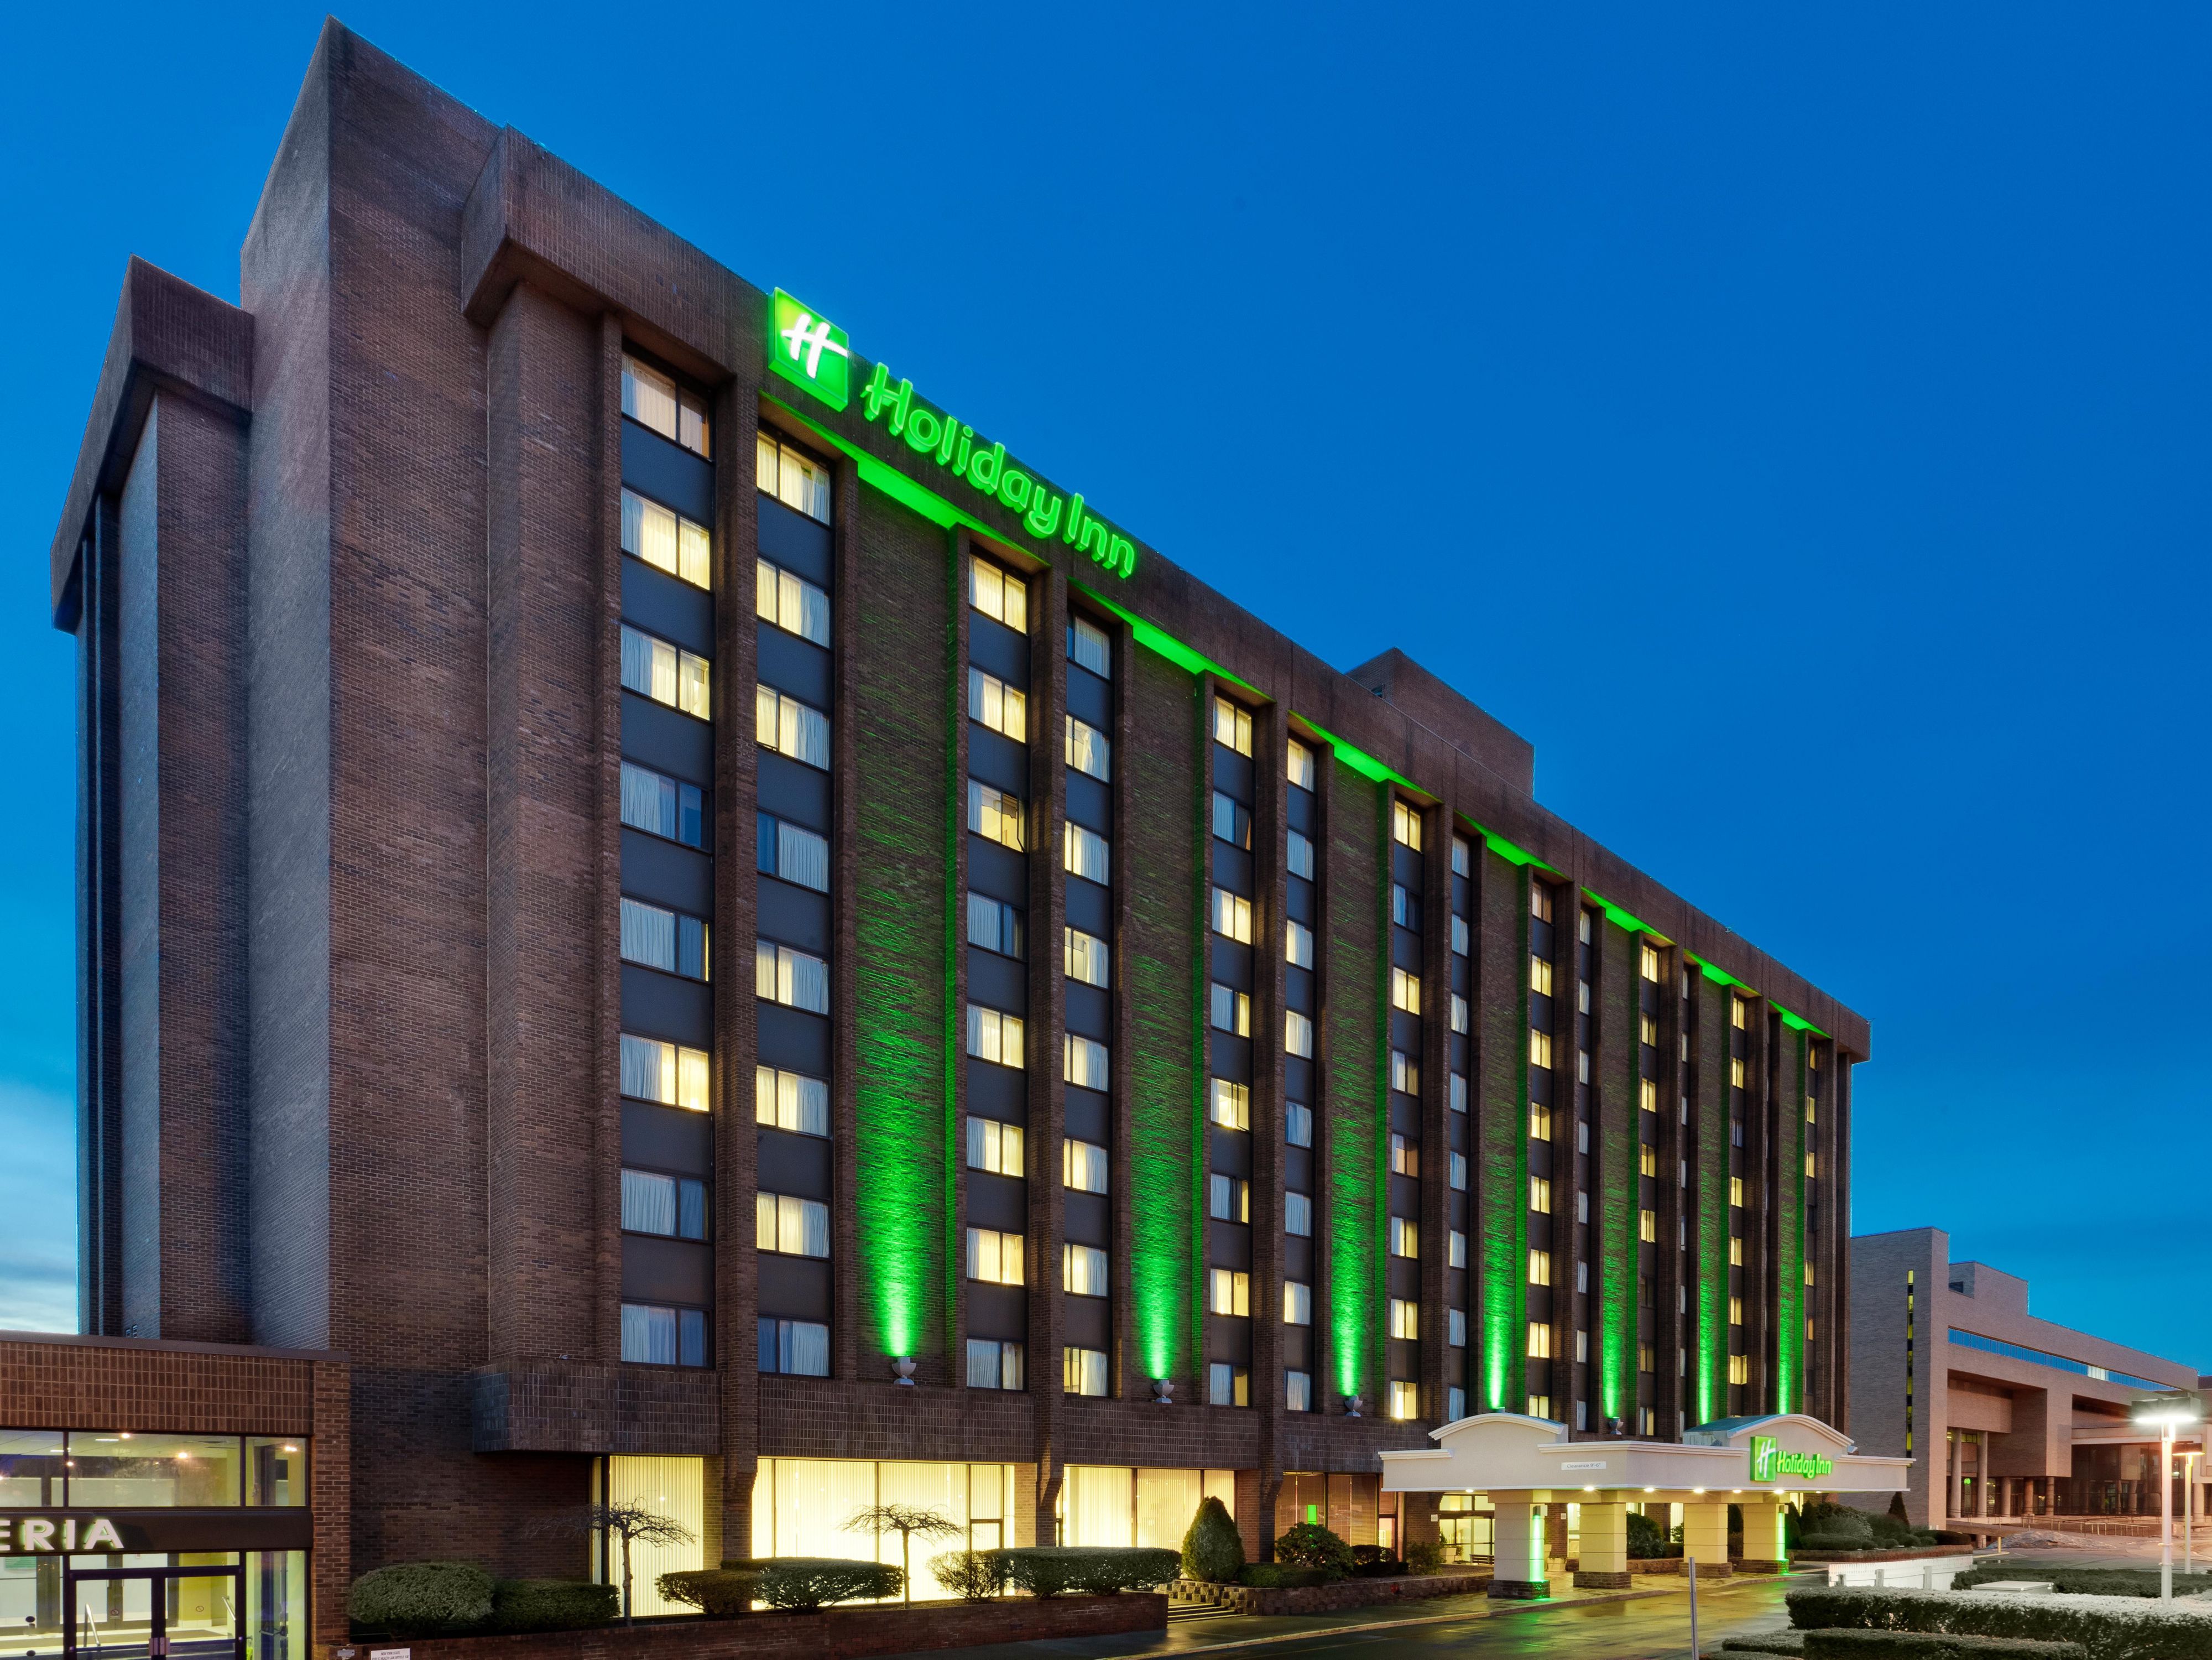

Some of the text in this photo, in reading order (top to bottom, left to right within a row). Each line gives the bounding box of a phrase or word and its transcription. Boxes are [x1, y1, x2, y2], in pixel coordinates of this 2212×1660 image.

[862, 362, 1134, 578] Holiday Inn
[1777, 1450, 1832, 1479] Holiday Inn
